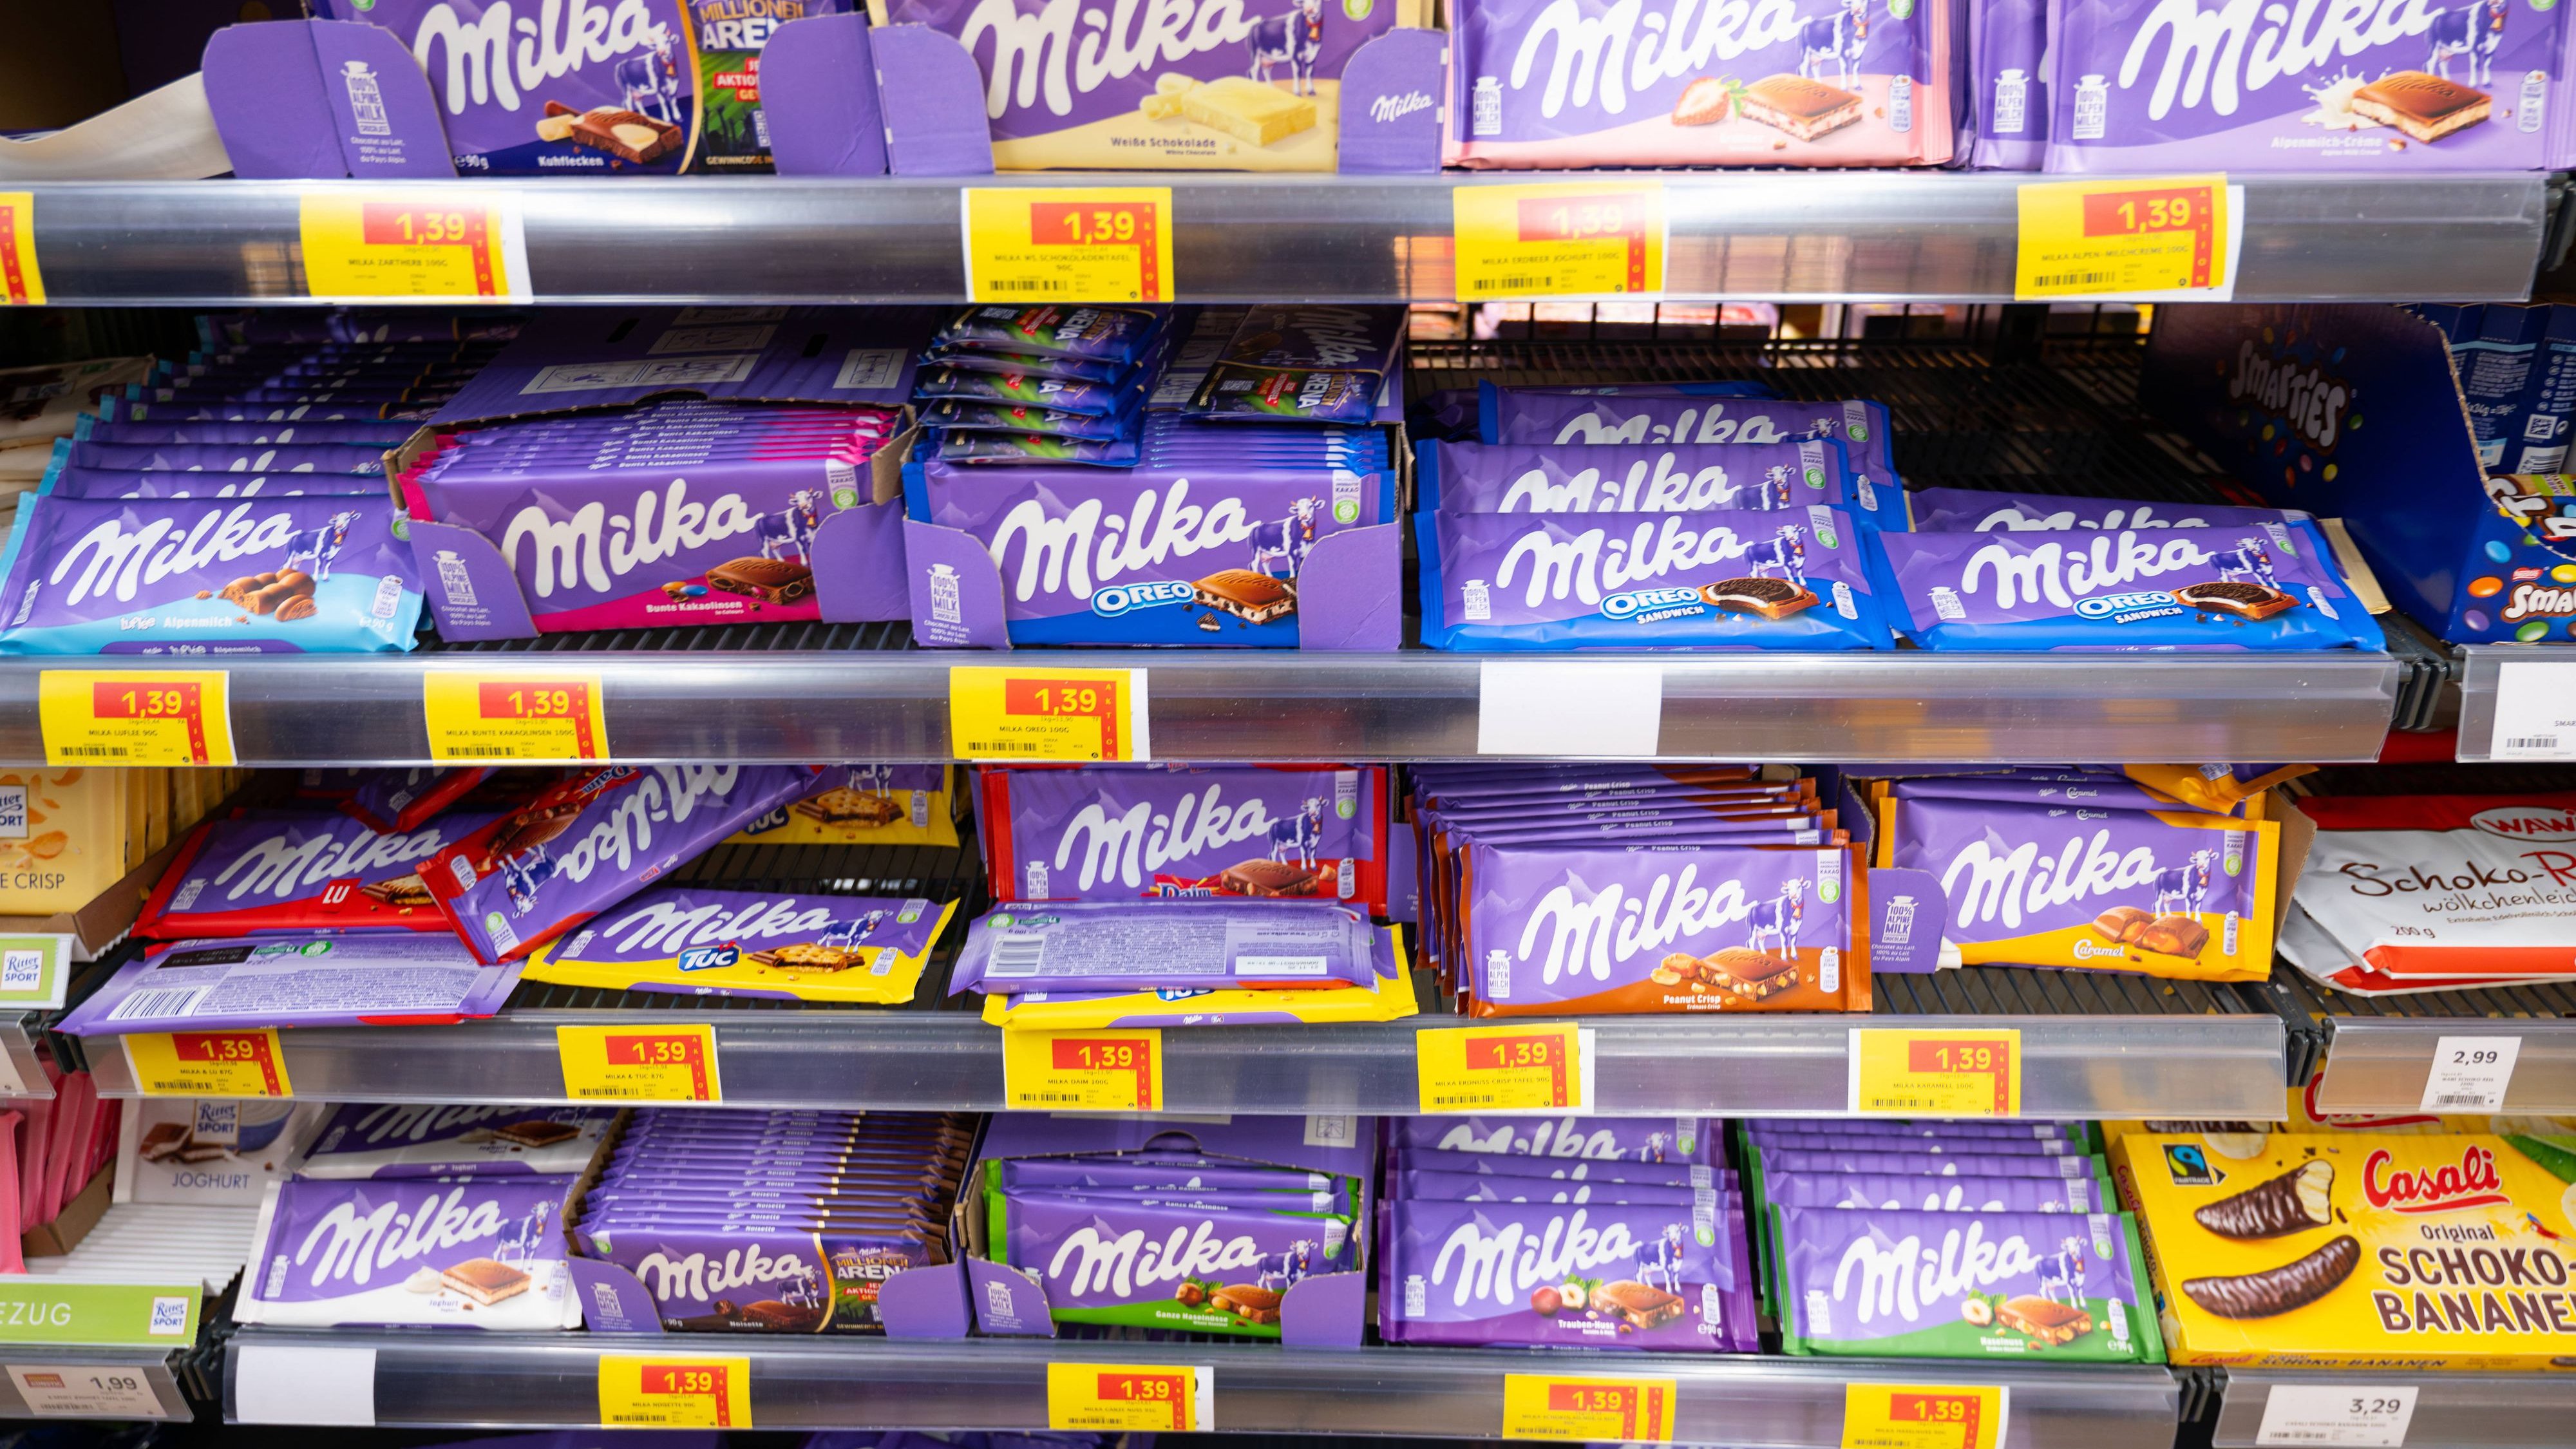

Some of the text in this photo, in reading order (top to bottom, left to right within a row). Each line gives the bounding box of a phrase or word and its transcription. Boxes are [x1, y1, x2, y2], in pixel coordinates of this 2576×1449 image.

[414, 0, 667, 115] Milka
[961, 0, 1262, 119] Milka
[1510, 0, 1815, 118] Milka
[2118, 0, 2445, 121] Milka
[1370, 90, 1434, 122] Milka
[1996, 98, 2023, 109] ALPEN
[2078, 104, 2103, 115] ALPEN
[1475, 113, 1499, 124] MILCH
[1996, 109, 2023, 120] MILCH
[2076, 115, 2103, 128] MILCH
[1111, 137, 1217, 148] Weiße Schokolade
[538, 155, 603, 168] Kuhflecken
[1551, 205, 1622, 240] 1,39
[2117, 197, 2190, 234] 1,39
[395, 212, 466, 245] 1,39
[1064, 211, 1135, 245] 1,39
[2041, 253, 2069, 261] MILKA
[503, 478, 764, 598] Milka
[989, 478, 1262, 601] Milka
[50, 502, 301, 605] Milka
[1496, 516, 1754, 607] Milka
[1962, 531, 2216, 609] Milka
[646, 601, 743, 613] Bunte Kakaolinsen
[934, 598, 958, 611] MILK
[1098, 583, 1191, 611] OREO
[1604, 589, 1701, 615] OREO
[2076, 592, 2175, 616] OREO
[164, 616, 232, 629] Alpenmilch
[1636, 604, 1705, 625] SANDWICH
[2114, 606, 2183, 625] SANDWICH
[121, 690, 182, 717] 1,39
[507, 690, 569, 718] 1,39
[1034, 688, 1097, 716] 1,39
[1104, 683, 1113, 758] AKTION
[2067, 787, 2098, 799] Caramel
[2076, 809, 2108, 820] Caramel
[1055, 783, 1280, 891] Milka
[214, 829, 450, 901] Milka
[1028, 870, 1048, 879] 100%
[15, 873, 65, 889] CRISP
[1939, 829, 2166, 929] Milka
[322, 886, 350, 904] LU
[1161, 884, 1211, 898] Daim
[1890, 906, 1912, 915] 100%
[603, 899, 838, 952] Milka
[1518, 864, 1758, 985] Milka
[1886, 923, 1909, 934] MILK
[2391, 925, 2436, 939] 200 g
[684, 948, 737, 969] TUC
[2073, 938, 2125, 959] Caramel
[7, 956, 39, 971] Ritter
[1490, 961, 1508, 971] 100%
[5, 973, 38, 981] SPORT
[1489, 971, 1508, 979] ALPEN
[1489, 980, 1509, 988] MILCH
[1663, 994, 1721, 1005] Peanut Crisp
[1183, 1014, 1203, 1025] Milka
[200, 1039, 254, 1061] 1,39
[632, 1041, 685, 1064] 1,39
[1078, 1046, 1133, 1069] 1,39
[1492, 1042, 1548, 1068] 1,39
[1935, 1047, 1991, 1072] 1,39
[2453, 1051, 2497, 1066] 2,99
[692, 1036, 705, 1099] AKTION
[197, 1122, 234, 1133] SPORT
[172, 1172, 251, 1189] JOGHURT
[2363, 1145, 2499, 1208] Casali
[296, 1187, 509, 1287] Milka
[2421, 1224, 2495, 1243] Original
[859, 1247, 881, 1256] Milka
[1048, 1219, 1267, 1298] Milka
[1432, 1208, 1642, 1307] Milka
[636, 1244, 813, 1302] Milka
[1833, 1220, 2042, 1323] Milka
[2379, 1248, 2576, 1285] SCHOKO-
[430, 1300, 459, 1308] Joghurt
[154, 1318, 184, 1327] SPORT
[1156, 1311, 1228, 1322] Ganze Haselnüsse
[1558, 1320, 1615, 1329] Trauben-Nuss
[90, 1377, 137, 1391] 1,99
[664, 1372, 712, 1394] 1,39
[1121, 1380, 1170, 1401] 1,39
[1572, 1390, 1622, 1412] 1,39
[1914, 1400, 1964, 1421] 1,39
[2349, 1398, 2401, 1416] 3,29
